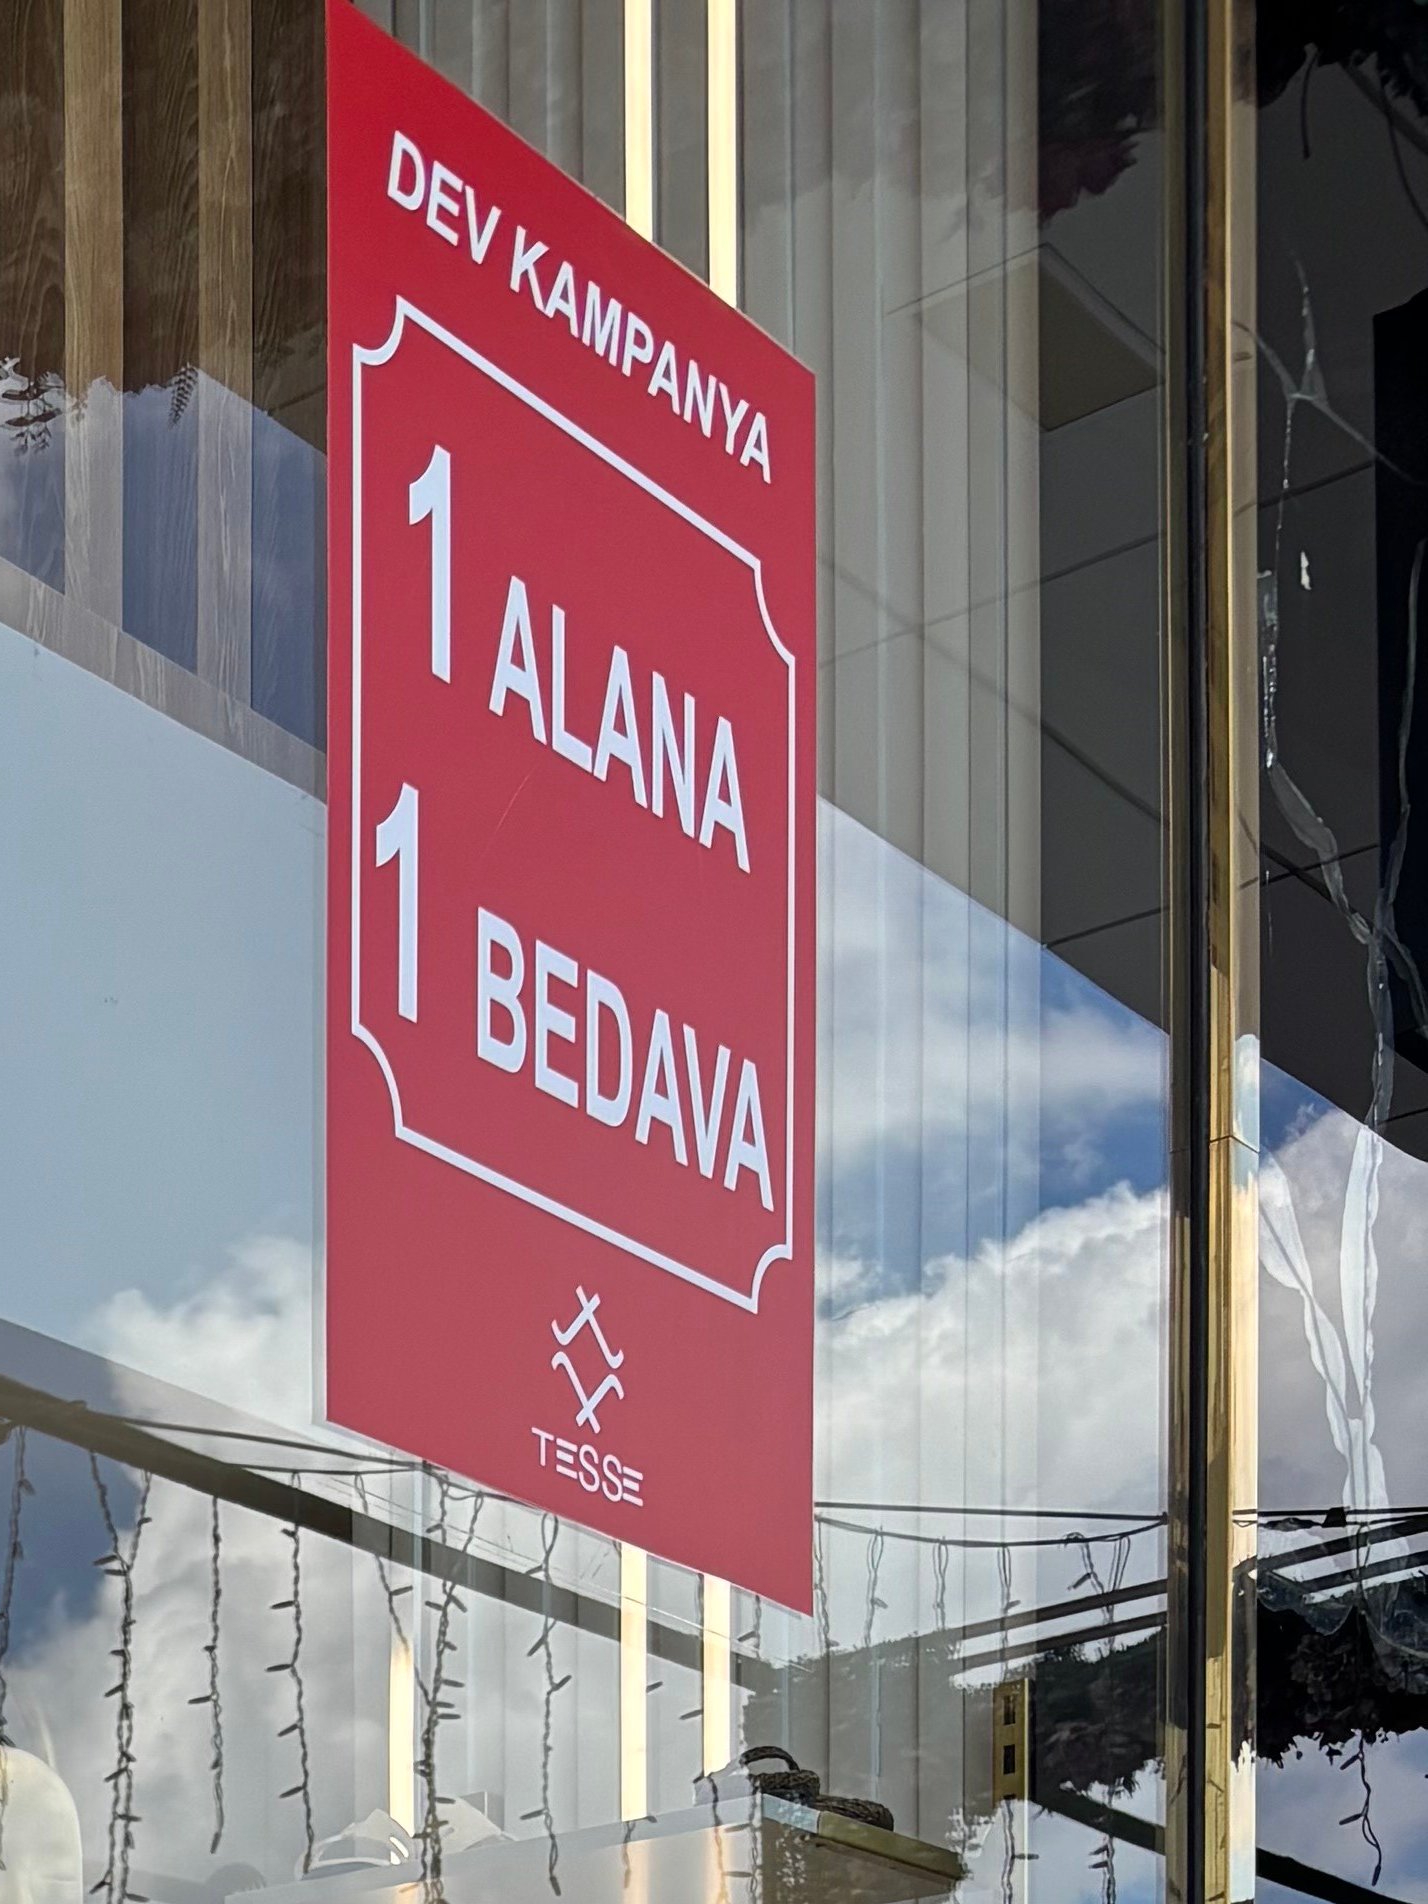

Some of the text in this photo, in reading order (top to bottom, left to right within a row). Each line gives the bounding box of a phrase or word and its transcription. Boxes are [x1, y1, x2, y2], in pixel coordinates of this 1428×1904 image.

[386, 129, 772, 485] DEV KAMPANYA
[407, 443, 752, 875] 1 ALANA
[374, 781, 776, 1213] 1 BEDAVA
[530, 1425, 645, 1508] TESSE
